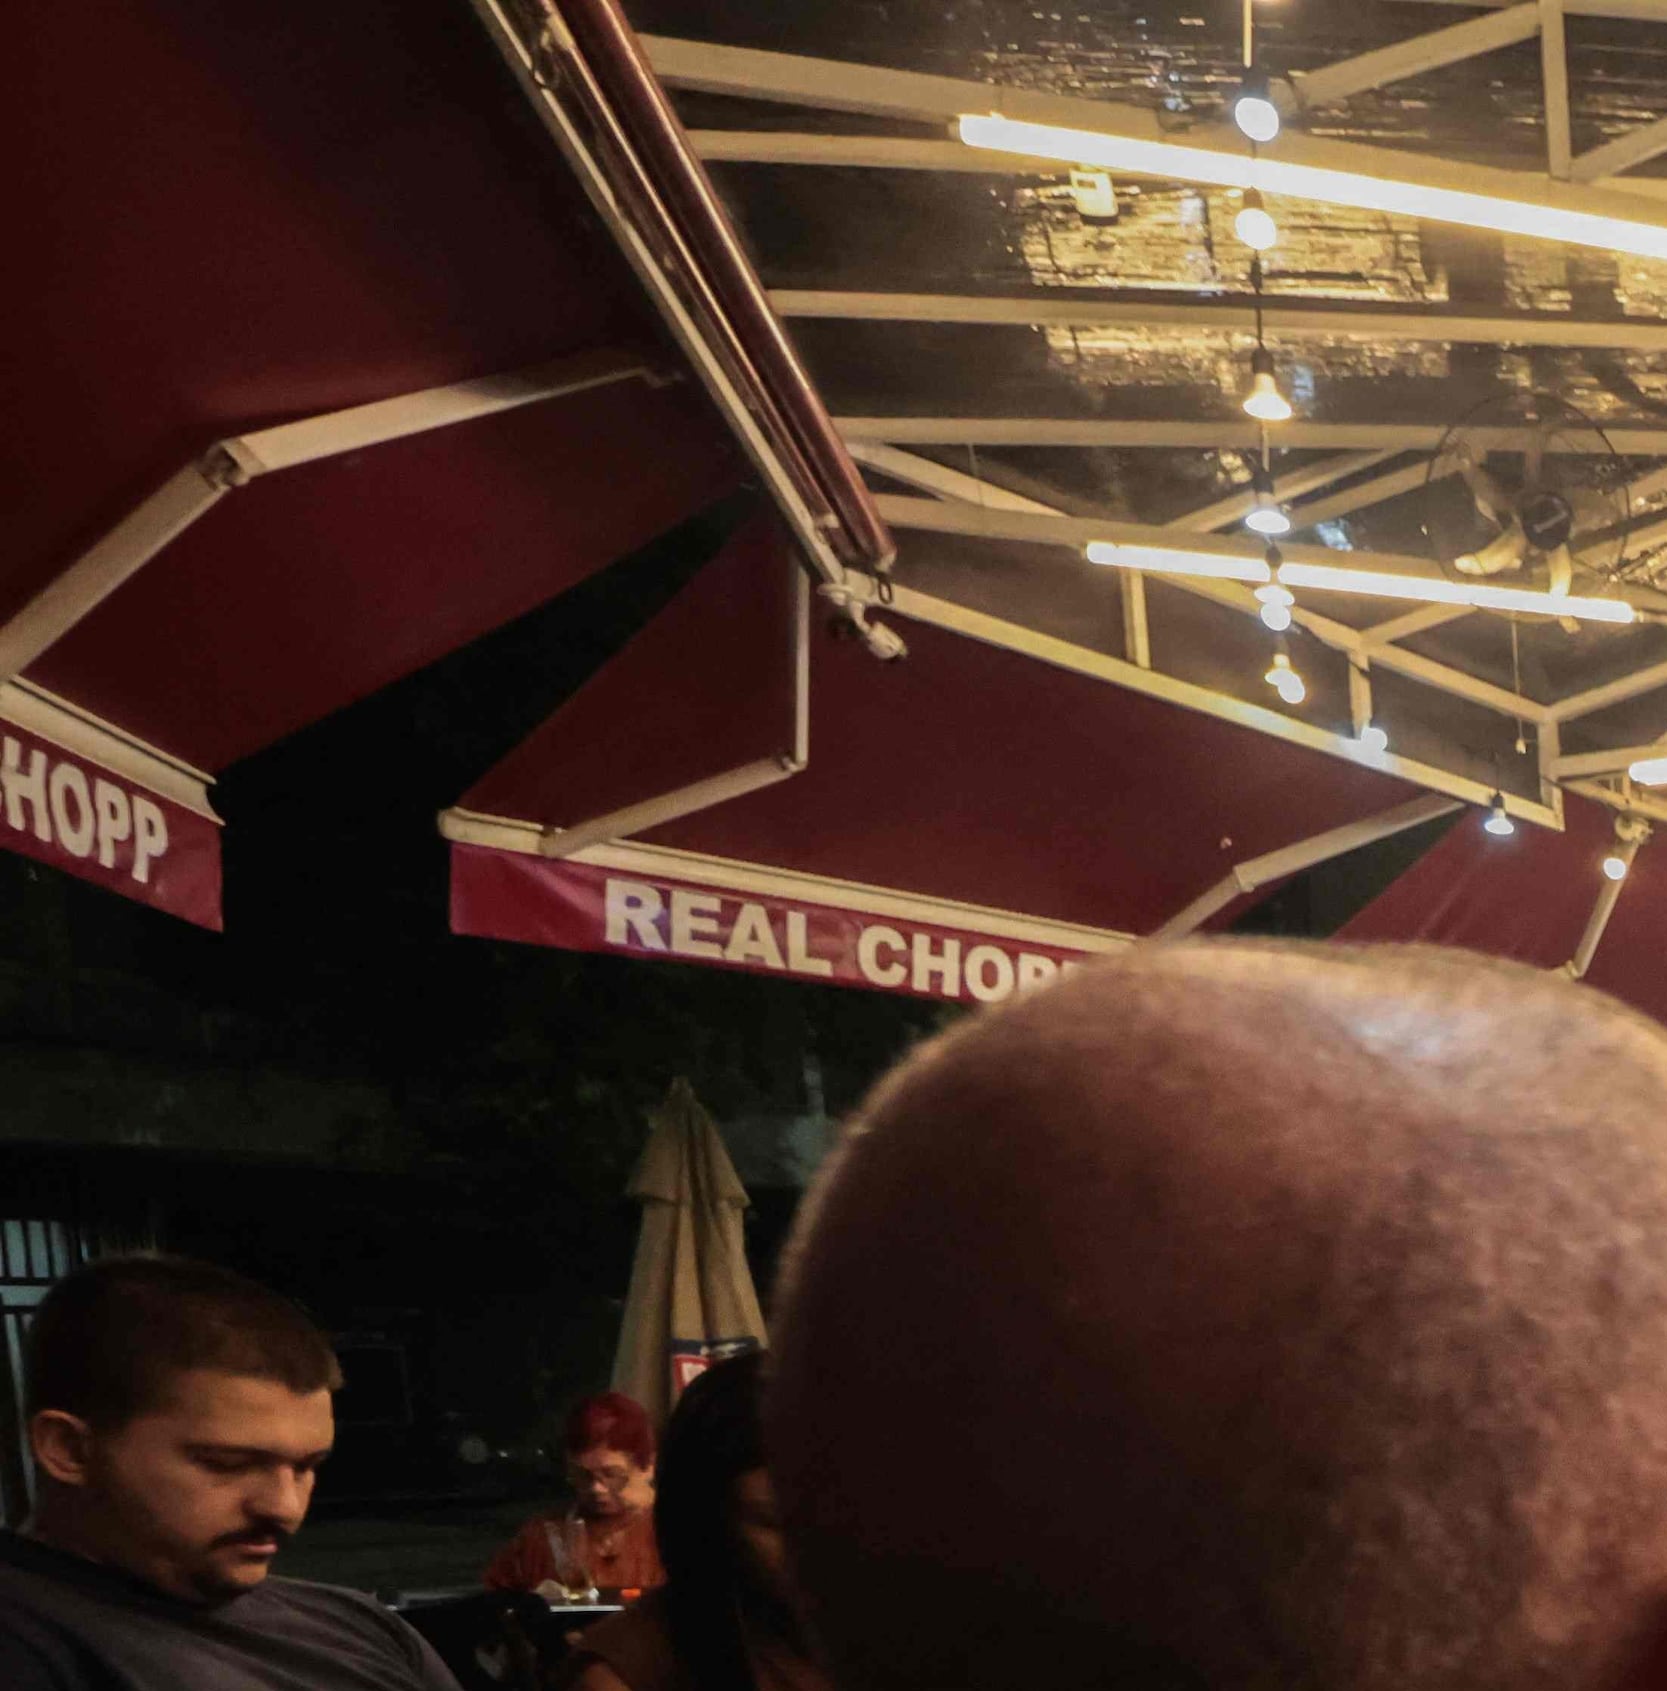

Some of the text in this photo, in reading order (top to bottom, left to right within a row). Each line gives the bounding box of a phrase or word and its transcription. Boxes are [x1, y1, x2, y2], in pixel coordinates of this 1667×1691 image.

[0, 736, 168, 883] HOPP
[603, 878, 1082, 1002] REAL CHOP
